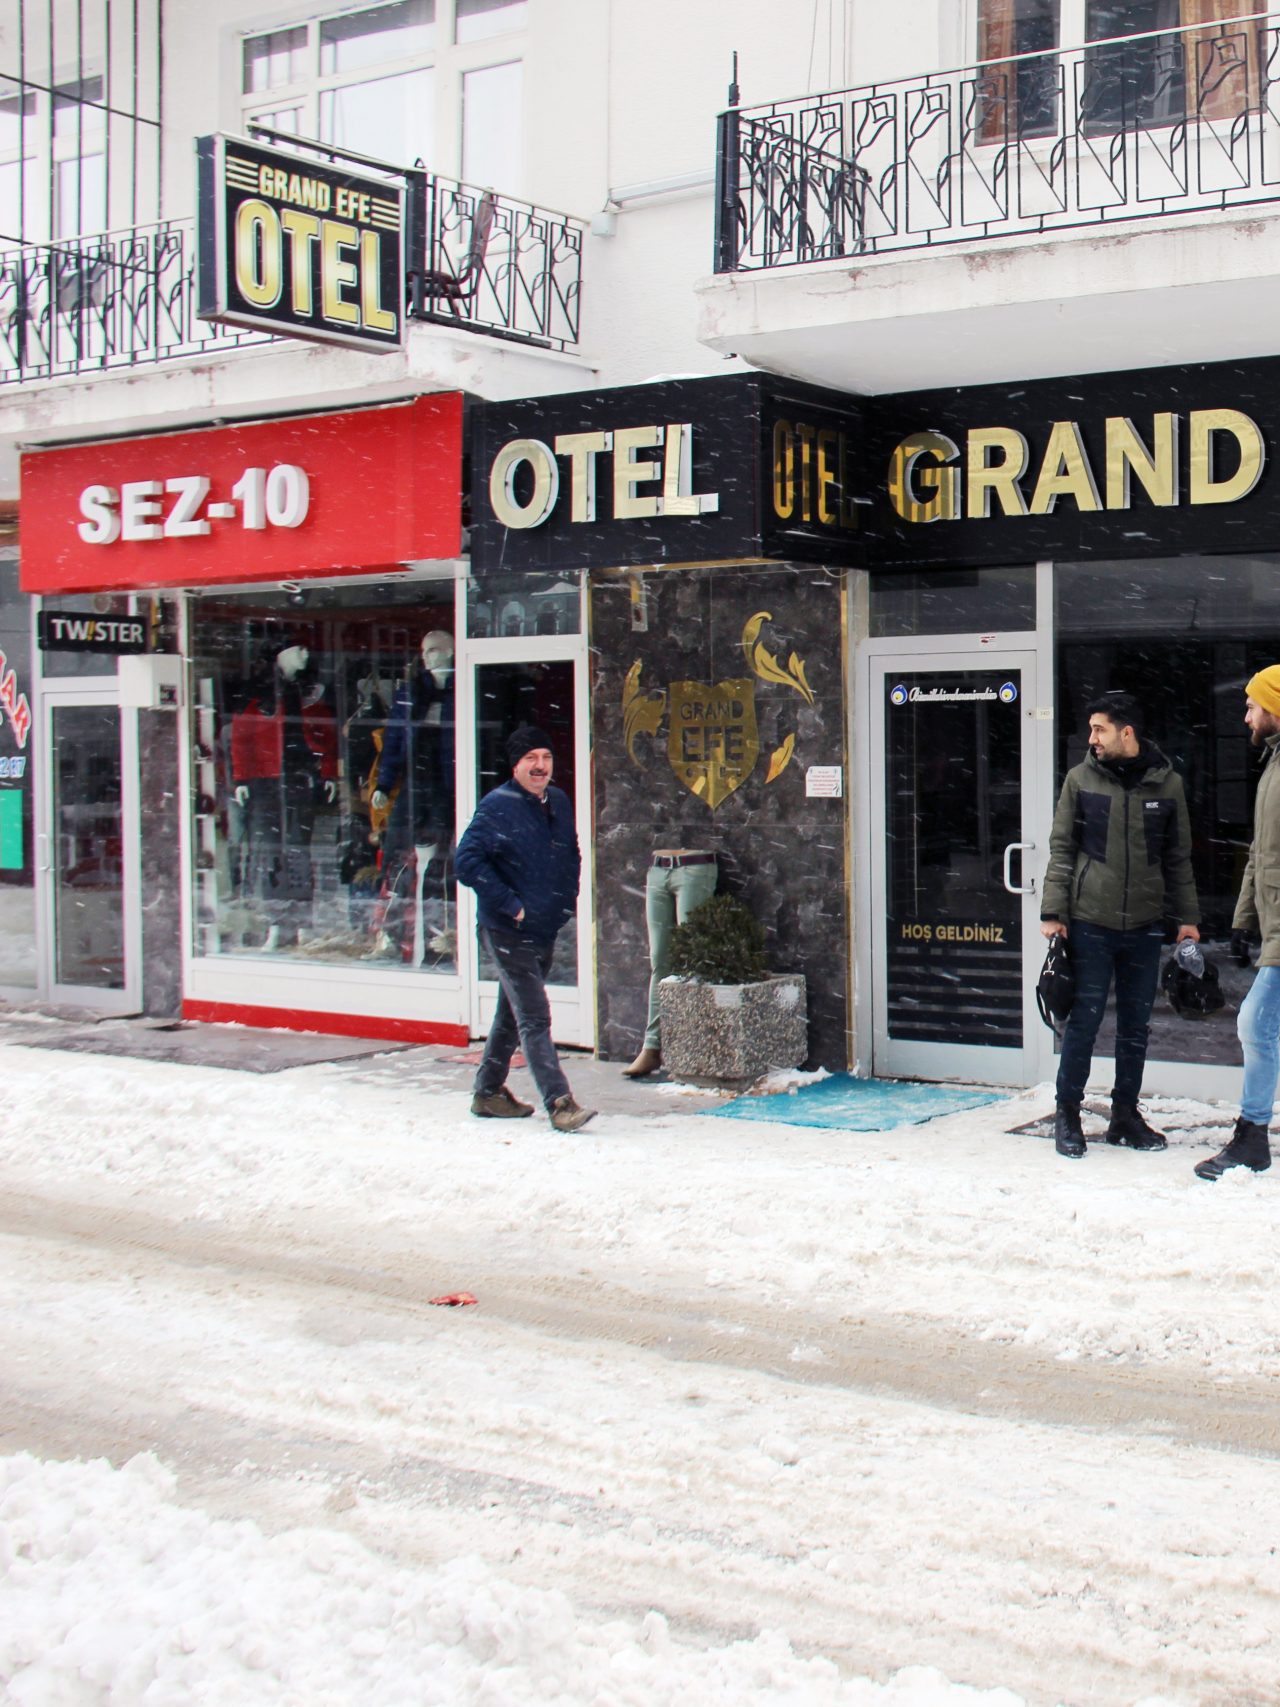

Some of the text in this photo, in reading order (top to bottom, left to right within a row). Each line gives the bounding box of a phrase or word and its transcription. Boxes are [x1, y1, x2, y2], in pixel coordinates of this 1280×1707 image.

[259, 163, 372, 225] GRAND EFE
[234, 197, 397, 334] OTEL
[489, 423, 719, 530] OTEL
[887, 408, 1266, 524] GRAND
[77, 463, 310, 545] SEZ-10
[680, 700, 744, 721] GRAND
[682, 725, 745, 762] EFE
[902, 922, 1004, 943] HOŞ GELDİNİZ
